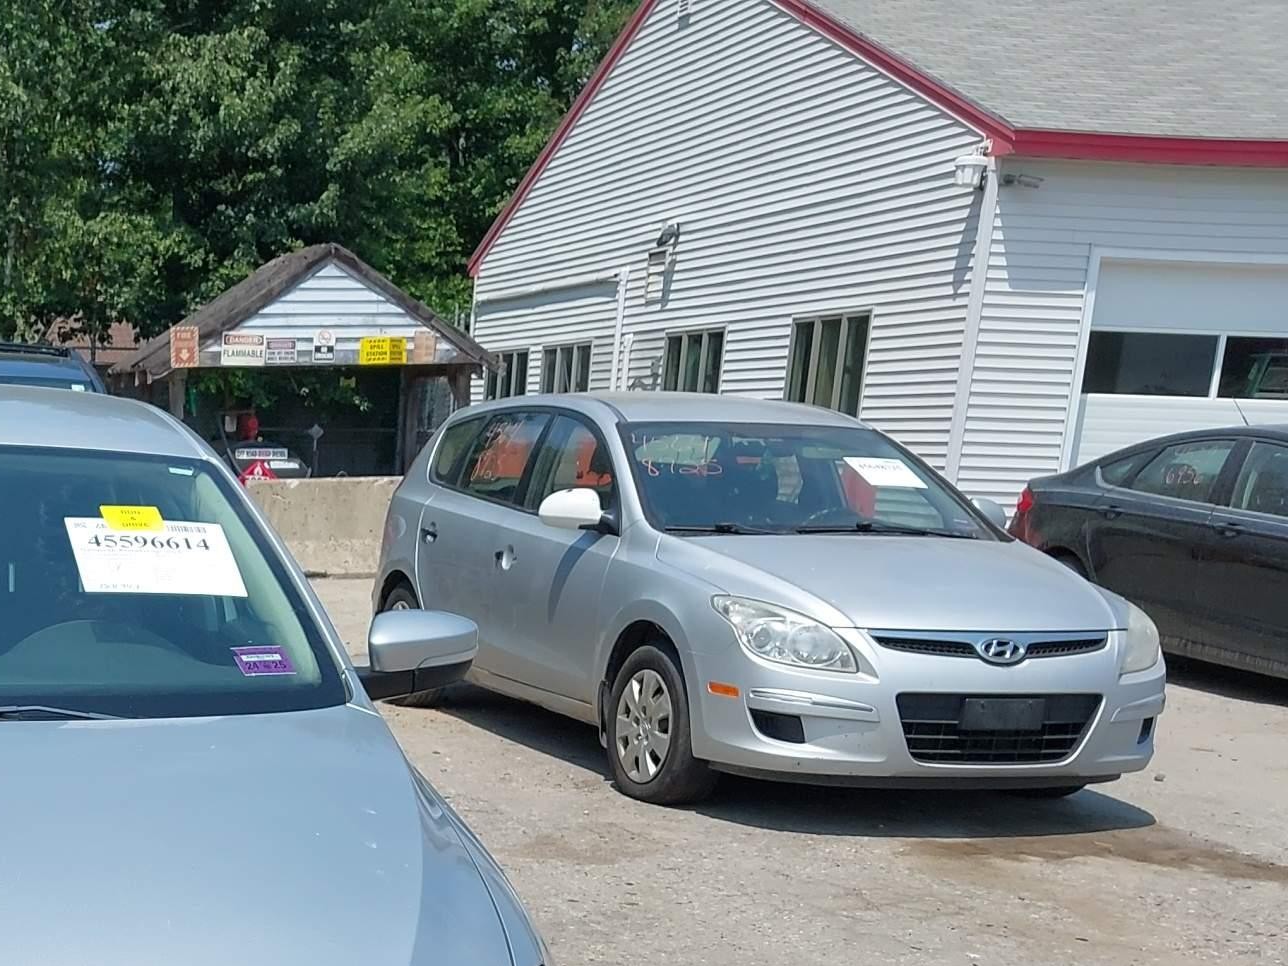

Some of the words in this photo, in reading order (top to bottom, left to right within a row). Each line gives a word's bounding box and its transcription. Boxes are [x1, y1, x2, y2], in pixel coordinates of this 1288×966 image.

[230, 335, 259, 344] DANGER
[223, 349, 263, 358] FLAMMABLE
[87, 533, 211, 551] 45596614
[245, 661, 259, 670] 24
[272, 661, 287, 669] 25
